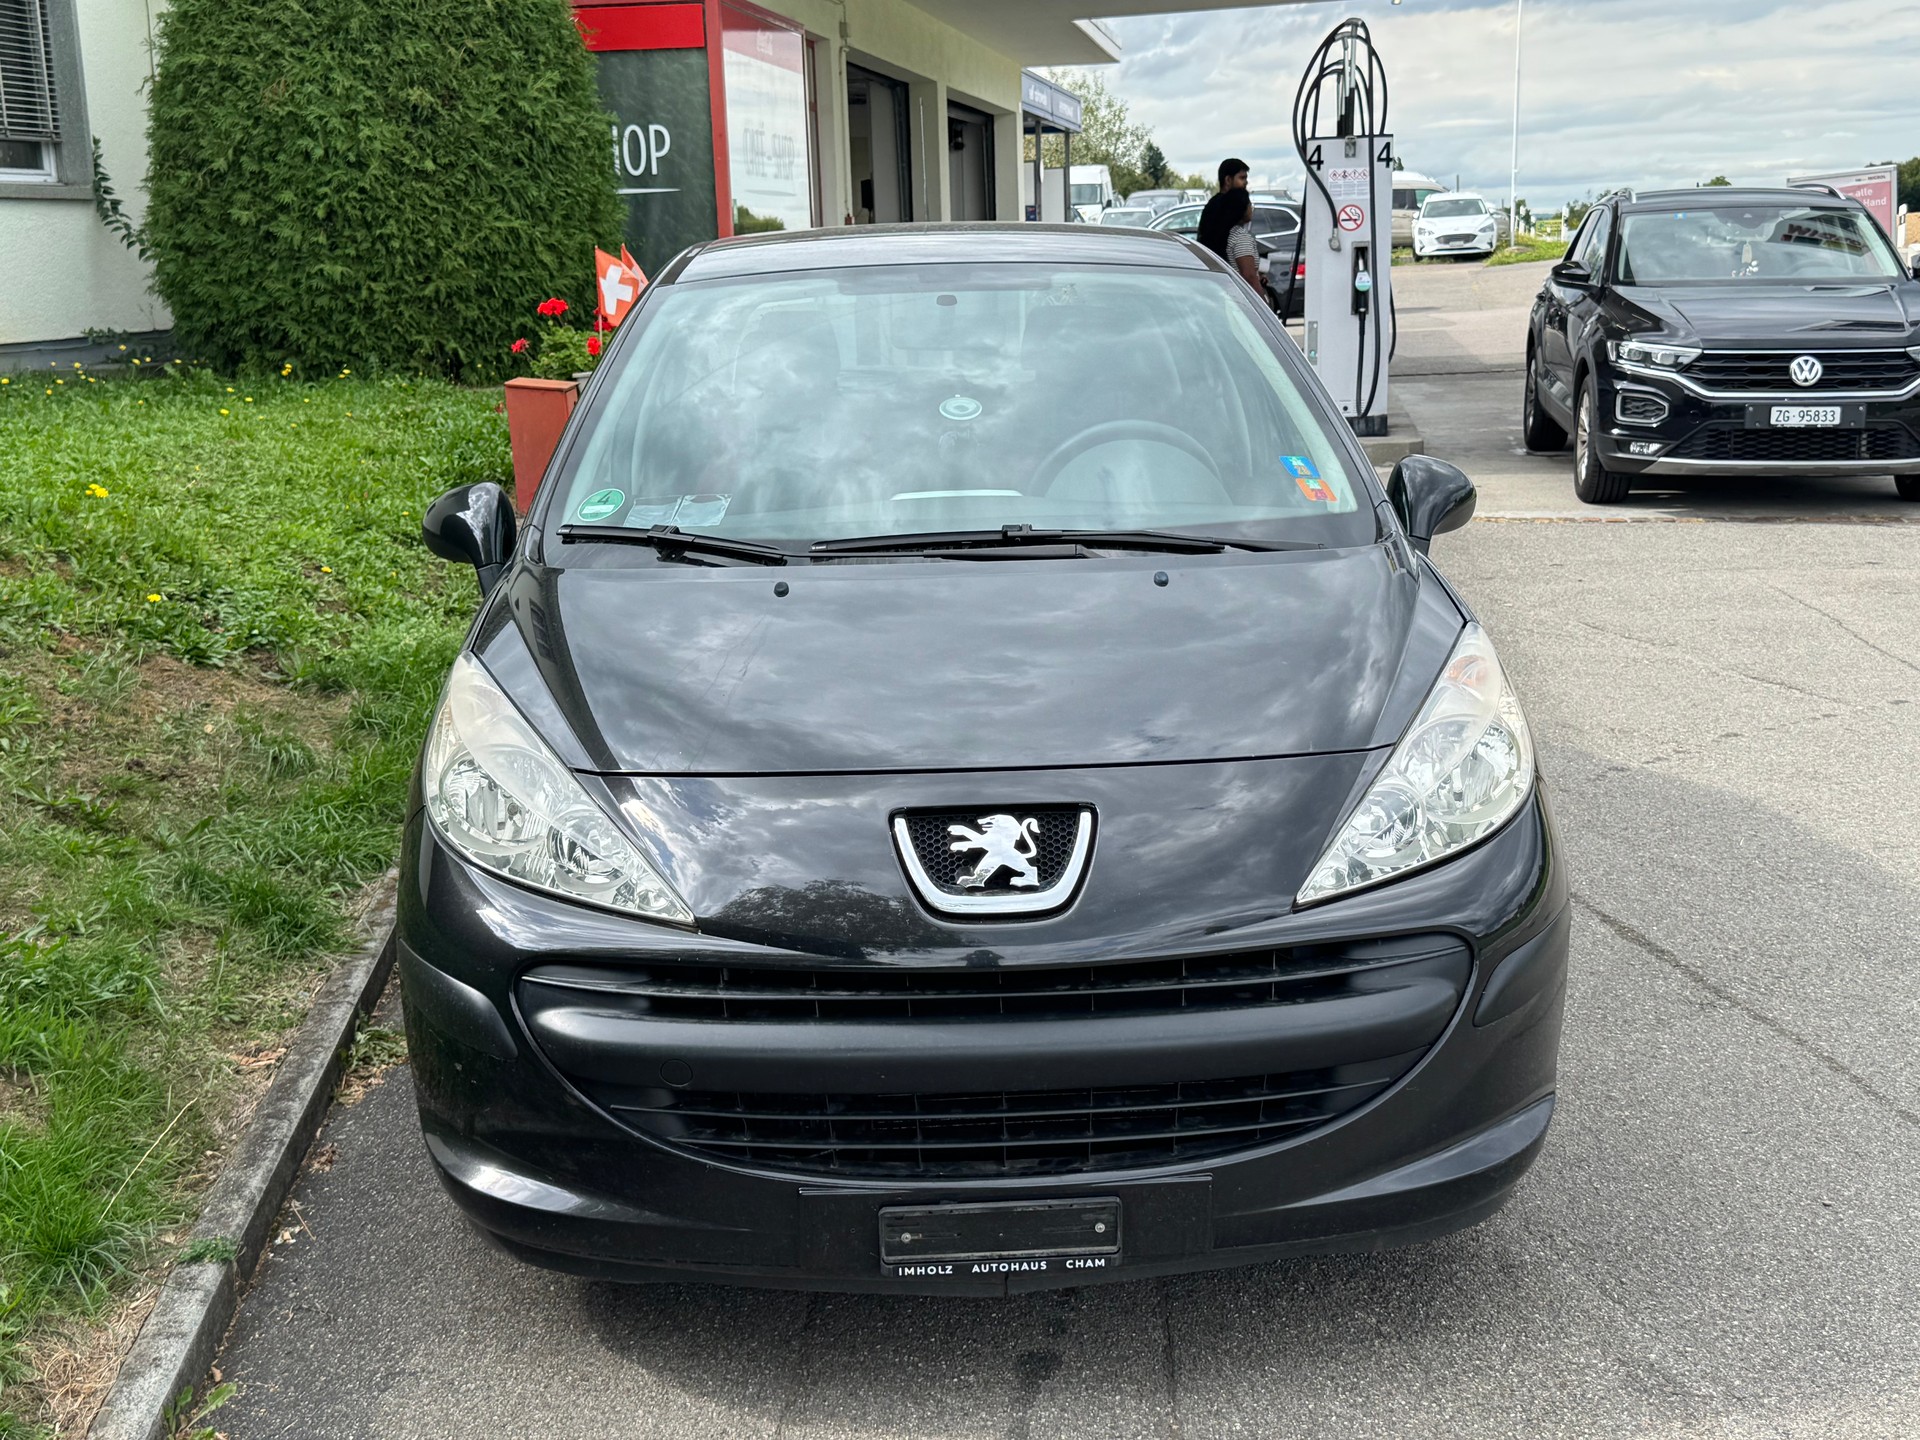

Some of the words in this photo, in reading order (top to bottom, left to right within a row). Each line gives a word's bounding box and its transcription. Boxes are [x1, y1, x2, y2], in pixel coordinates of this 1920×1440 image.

[612, 124, 671, 177] OP
[1307, 144, 1324, 171] 4
[1376, 141, 1393, 168] 4
[1855, 187, 1873, 198] alle
[1863, 196, 1887, 207] Hand
[597, 490, 612, 504] 4
[898, 1264, 954, 1277] IMHOLZ
[971, 1260, 1048, 1274] AUTOHAUS
[1065, 1258, 1106, 1270] CHAM
